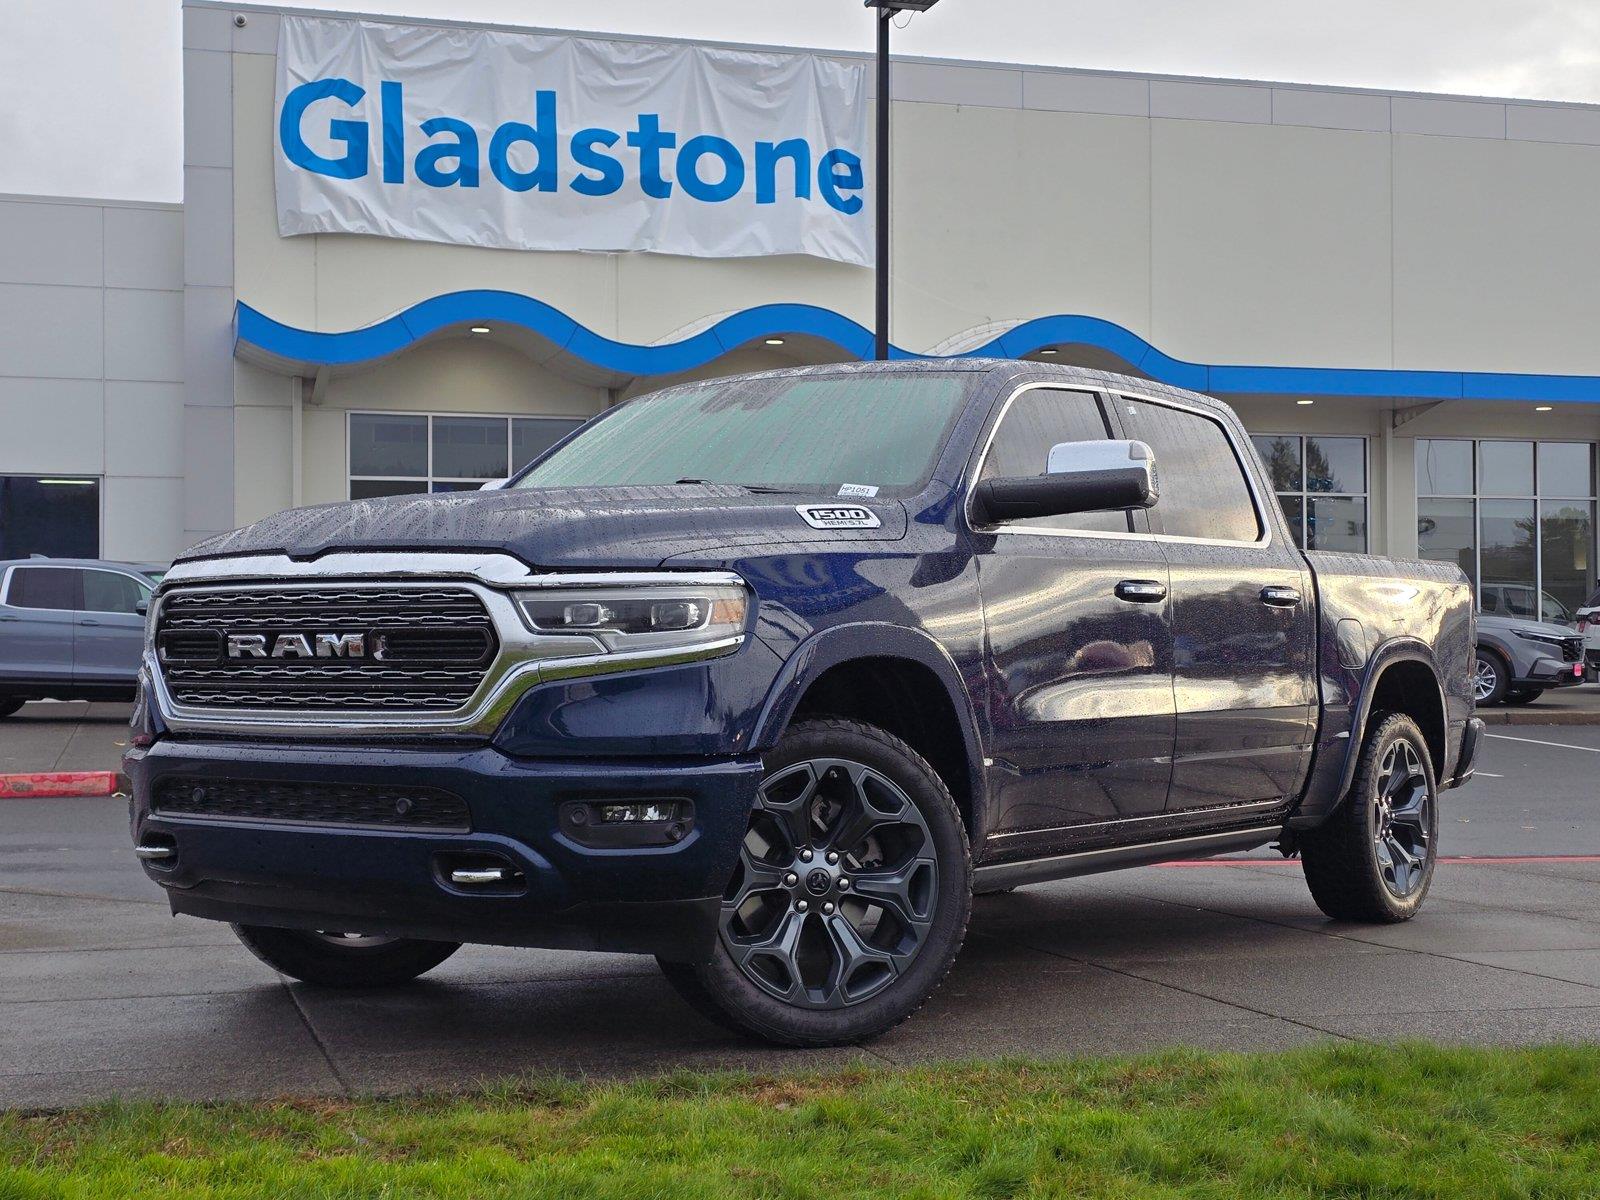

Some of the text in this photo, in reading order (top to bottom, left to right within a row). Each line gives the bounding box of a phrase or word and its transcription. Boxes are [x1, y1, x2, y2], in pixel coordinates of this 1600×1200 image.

[280, 79, 863, 215] Gladstone
[808, 509, 866, 519] 1500
[228, 633, 364, 657] RAM
